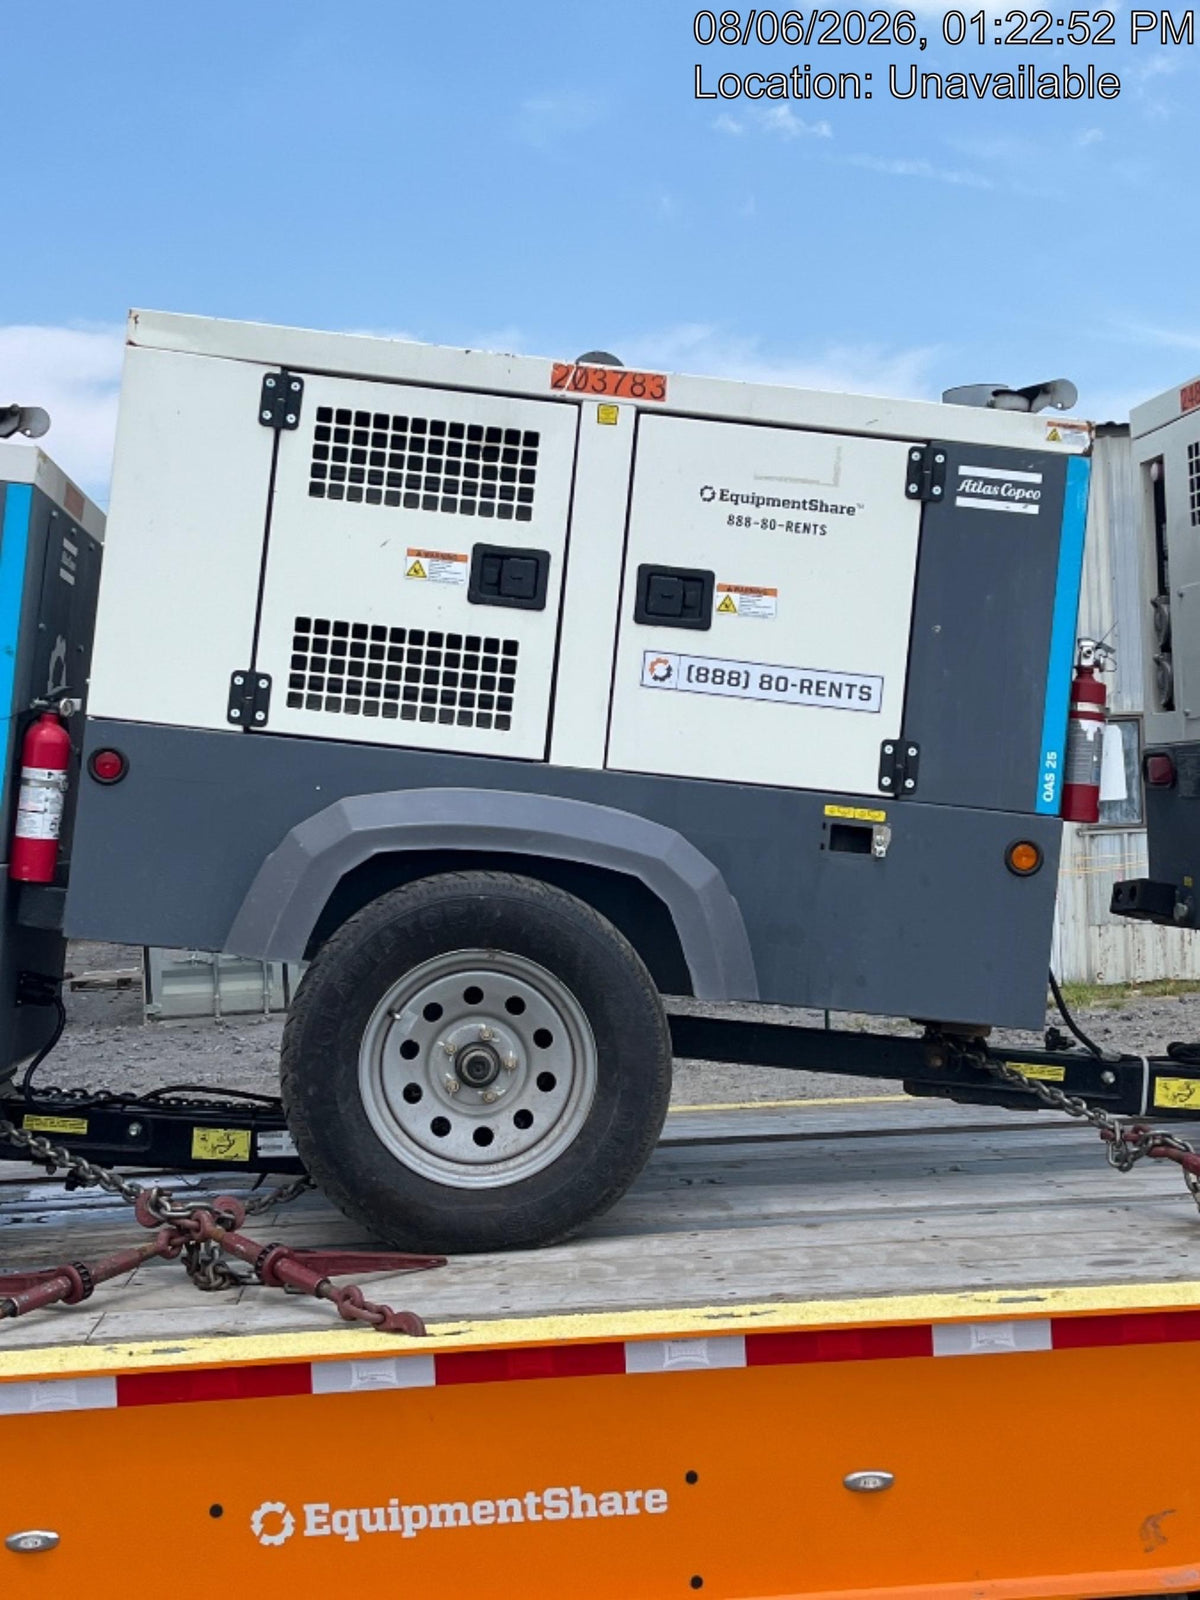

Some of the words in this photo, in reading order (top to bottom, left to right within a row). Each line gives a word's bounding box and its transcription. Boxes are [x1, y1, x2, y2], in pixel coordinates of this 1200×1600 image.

[552, 364, 666, 400] 203783
[957, 479, 1000, 497] Atlas
[1000, 483, 1041, 500] Copco
[726, 514, 828, 536] 888-80-RENTS
[686, 664, 750, 689] (888)
[759, 673, 873, 702] 80-RENTS
[1046, 751, 1057, 769] 25
[303, 1486, 668, 1542] EquipmentShare
